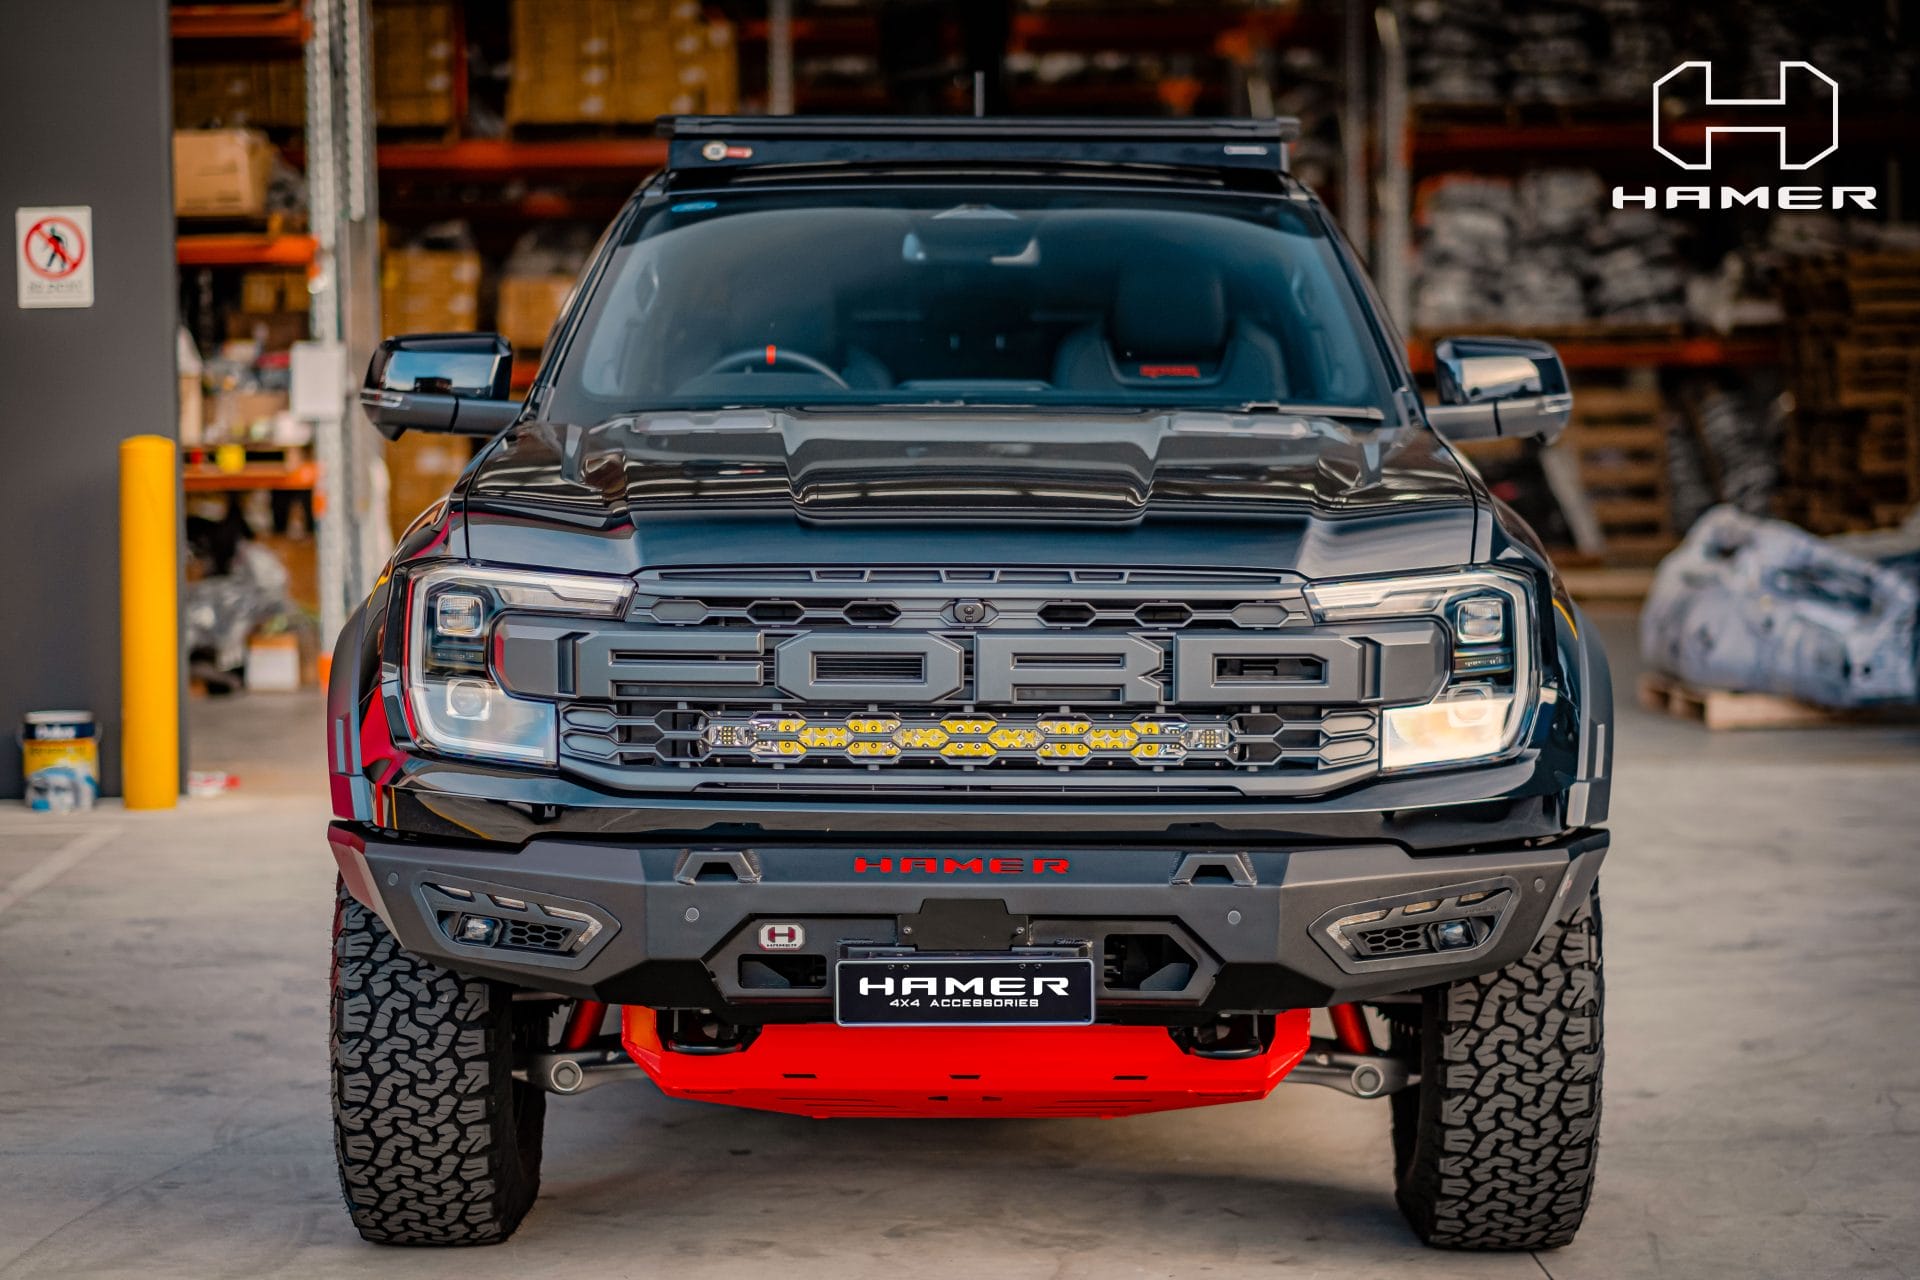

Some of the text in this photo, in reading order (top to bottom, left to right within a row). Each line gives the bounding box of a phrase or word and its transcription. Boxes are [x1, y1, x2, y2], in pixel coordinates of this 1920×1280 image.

[575, 630, 1366, 705] FORD
[854, 857, 1070, 874] HAMER
[859, 977, 1070, 996] HAMER
[930, 998, 1040, 1008] ACCESSORIES
